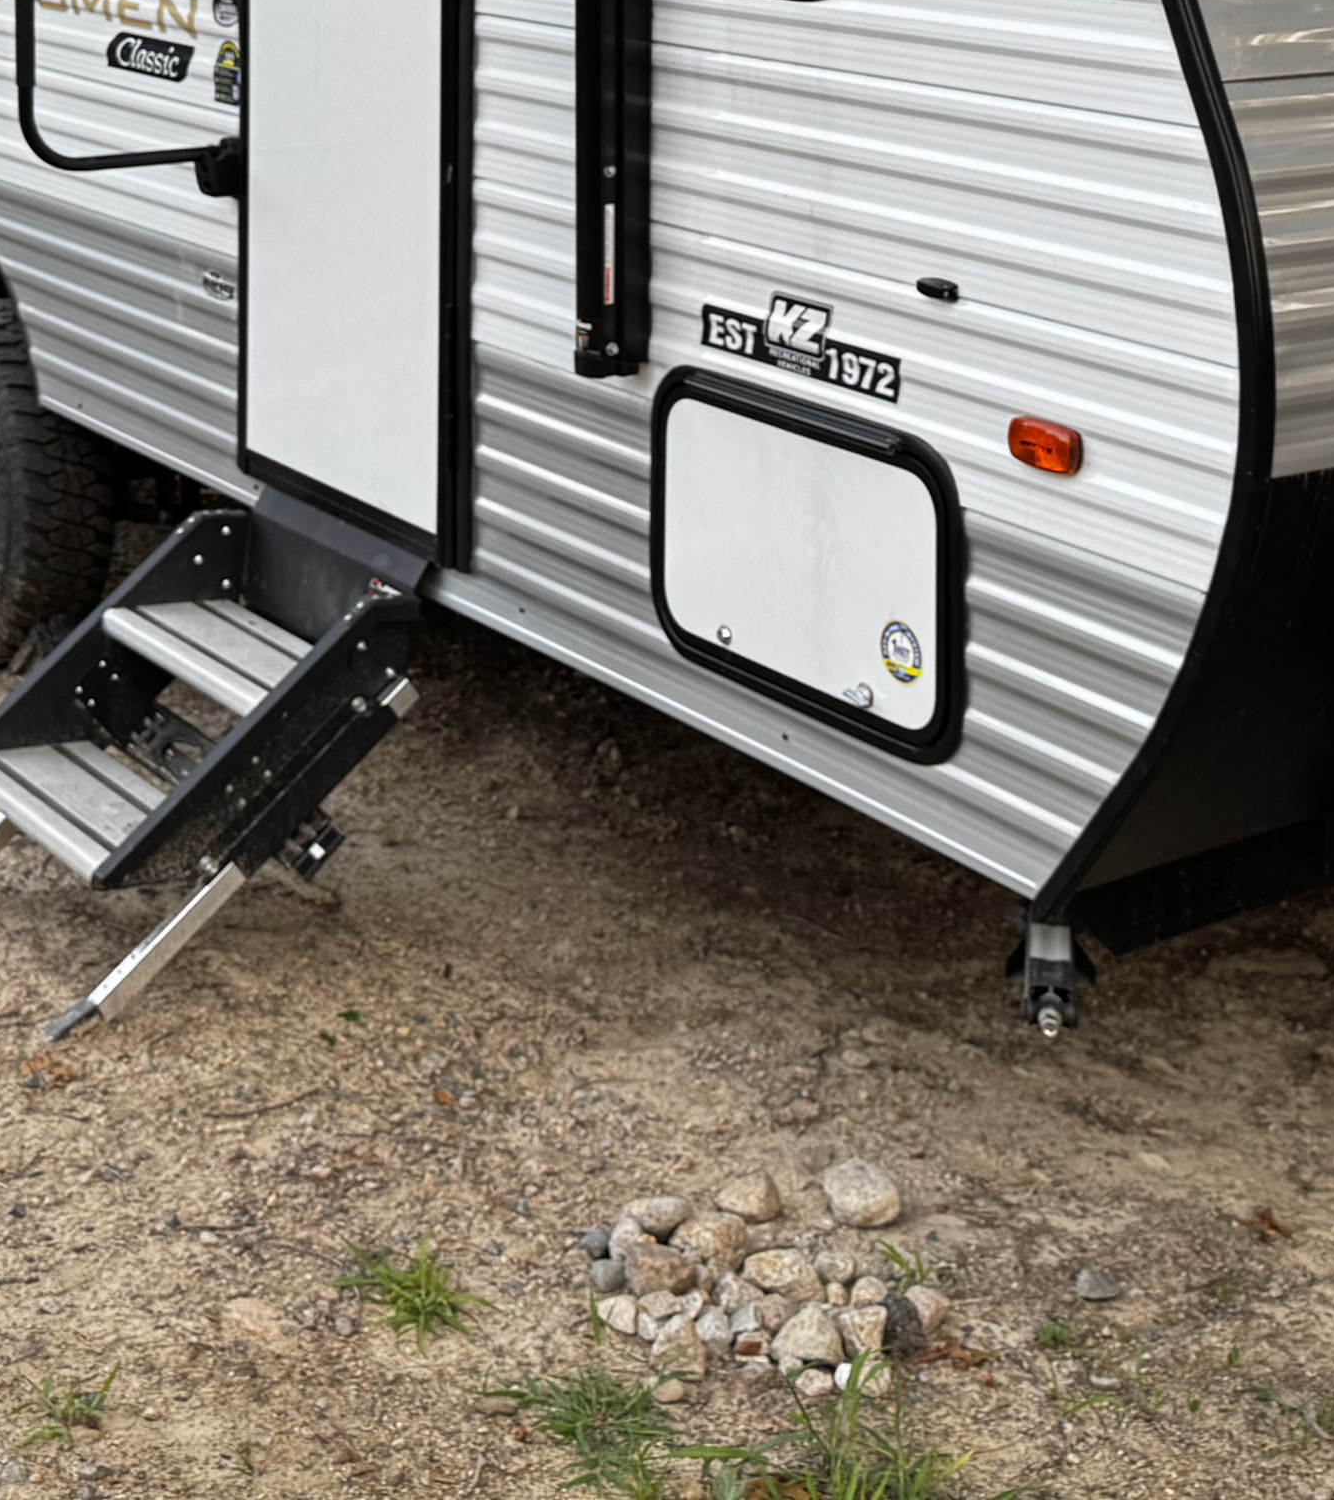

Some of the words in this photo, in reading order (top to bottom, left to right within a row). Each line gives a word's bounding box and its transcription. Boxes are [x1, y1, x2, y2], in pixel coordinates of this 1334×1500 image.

[116, 35, 181, 79] Classic
[708, 312, 758, 355] EST
[825, 347, 897, 398] 1972
[767, 298, 828, 356] KZ
